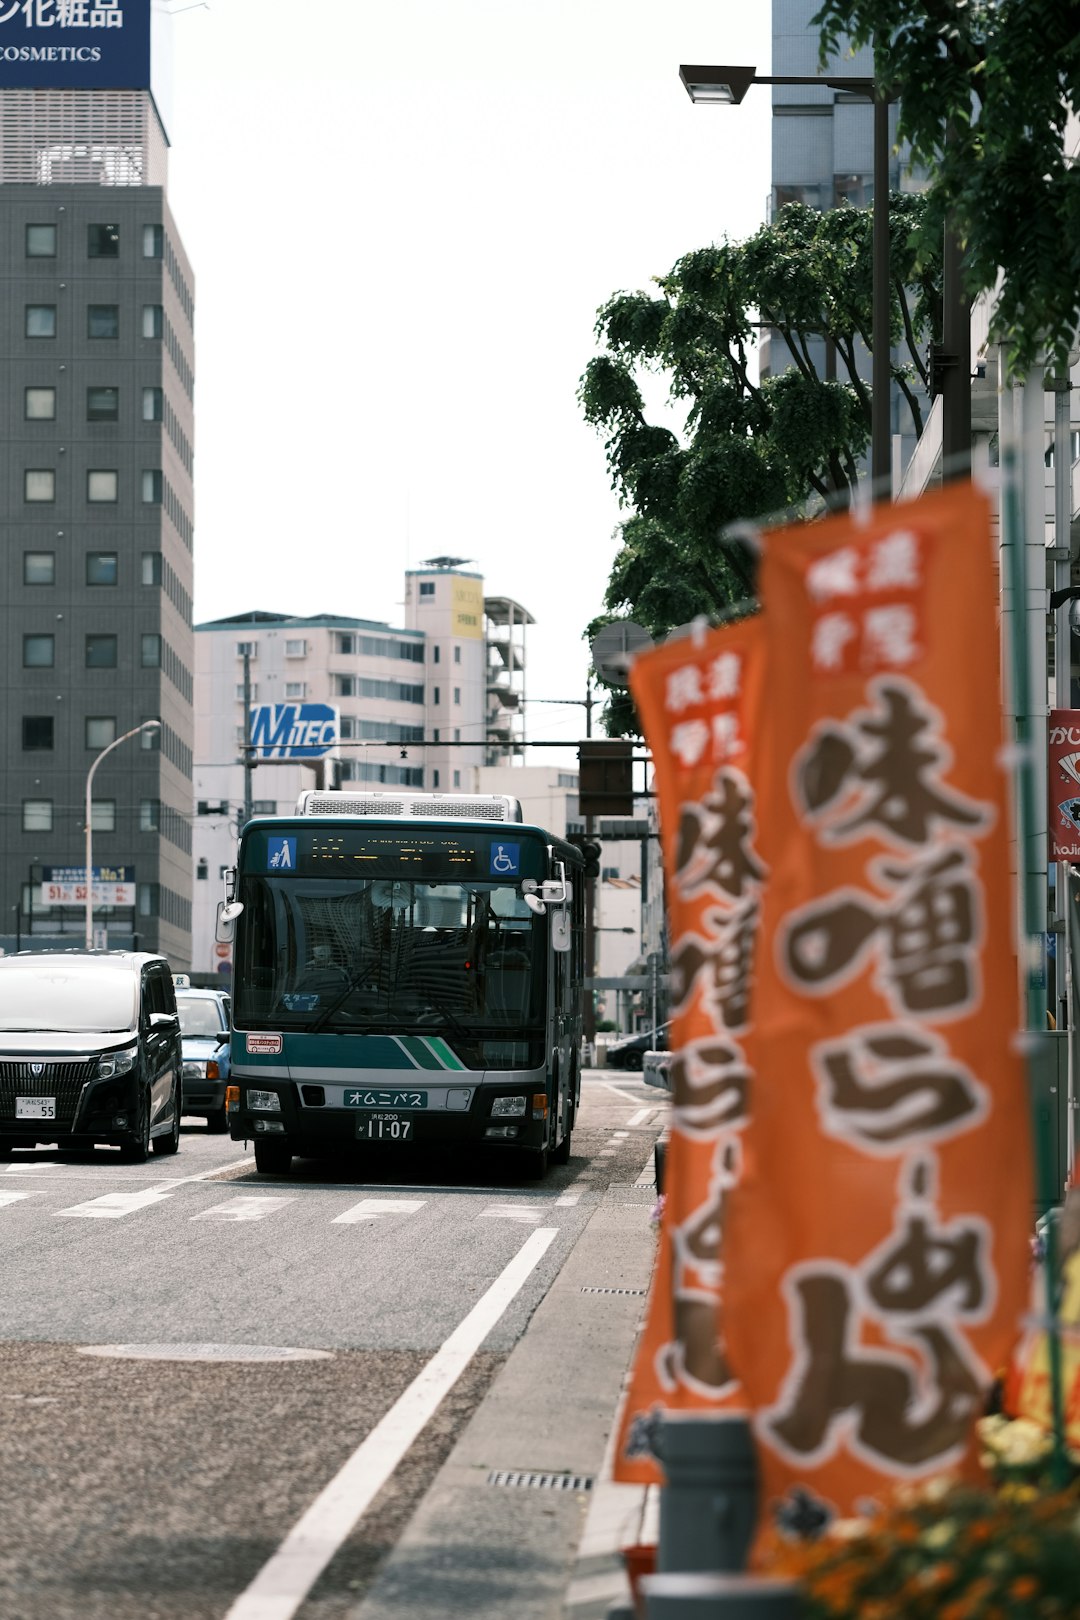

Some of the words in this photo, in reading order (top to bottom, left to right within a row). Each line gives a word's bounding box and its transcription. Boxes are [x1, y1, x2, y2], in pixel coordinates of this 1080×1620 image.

[349, 1092, 422, 1106] オムニバス
[368, 1120, 411, 1139] 11-07
